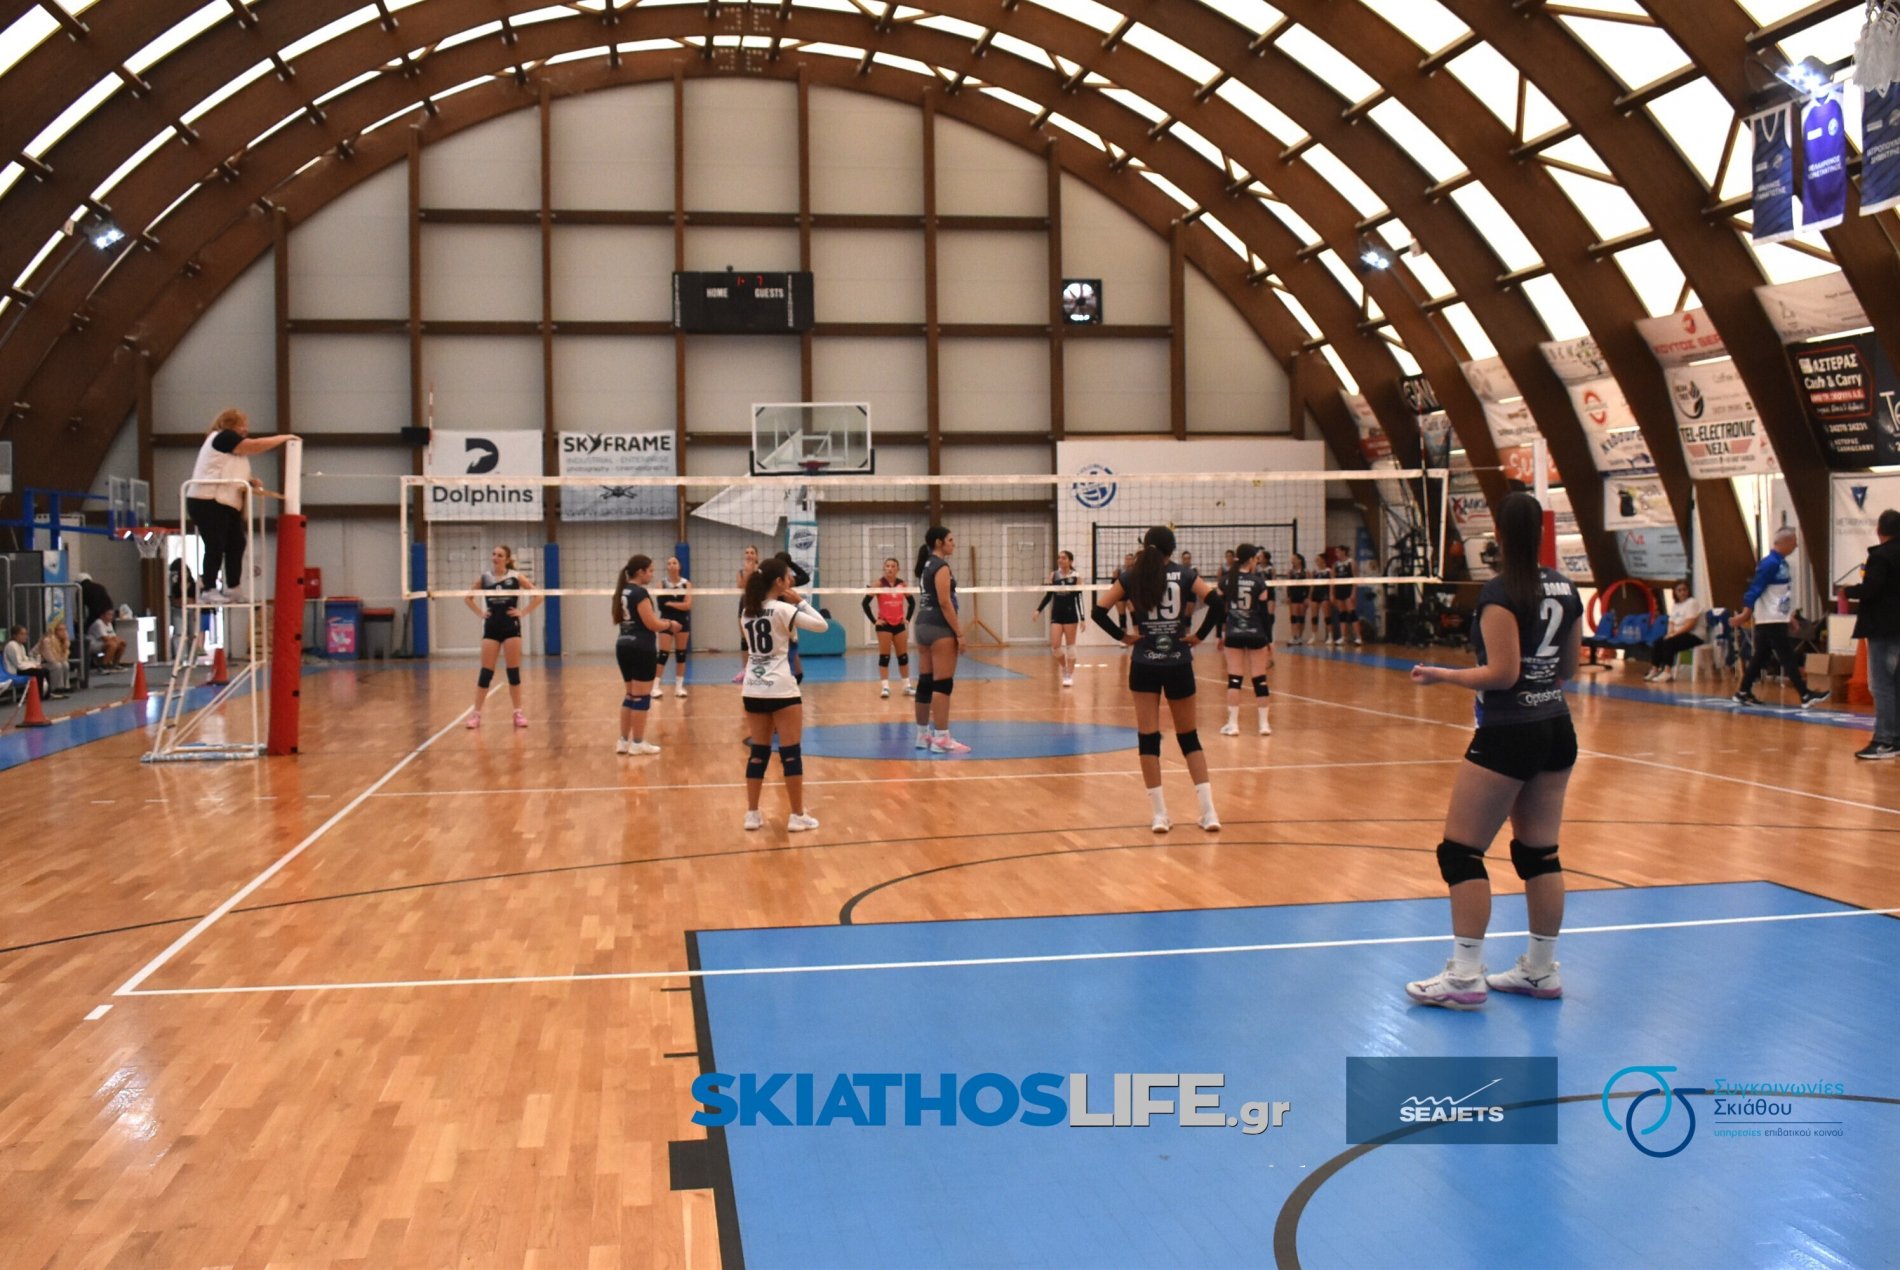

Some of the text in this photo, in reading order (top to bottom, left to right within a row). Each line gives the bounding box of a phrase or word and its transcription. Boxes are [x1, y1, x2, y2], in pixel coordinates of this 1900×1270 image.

[706, 288, 785, 298] HOME GUESTS
[1835, 374, 1863, 387] Carry
[1680, 419, 1756, 443] TEL-ELECTRONIC
[564, 433, 671, 454] SKYFRAME
[432, 484, 534, 506] Dolphins
[744, 618, 774, 654] 18
[1536, 598, 1564, 656] 2
